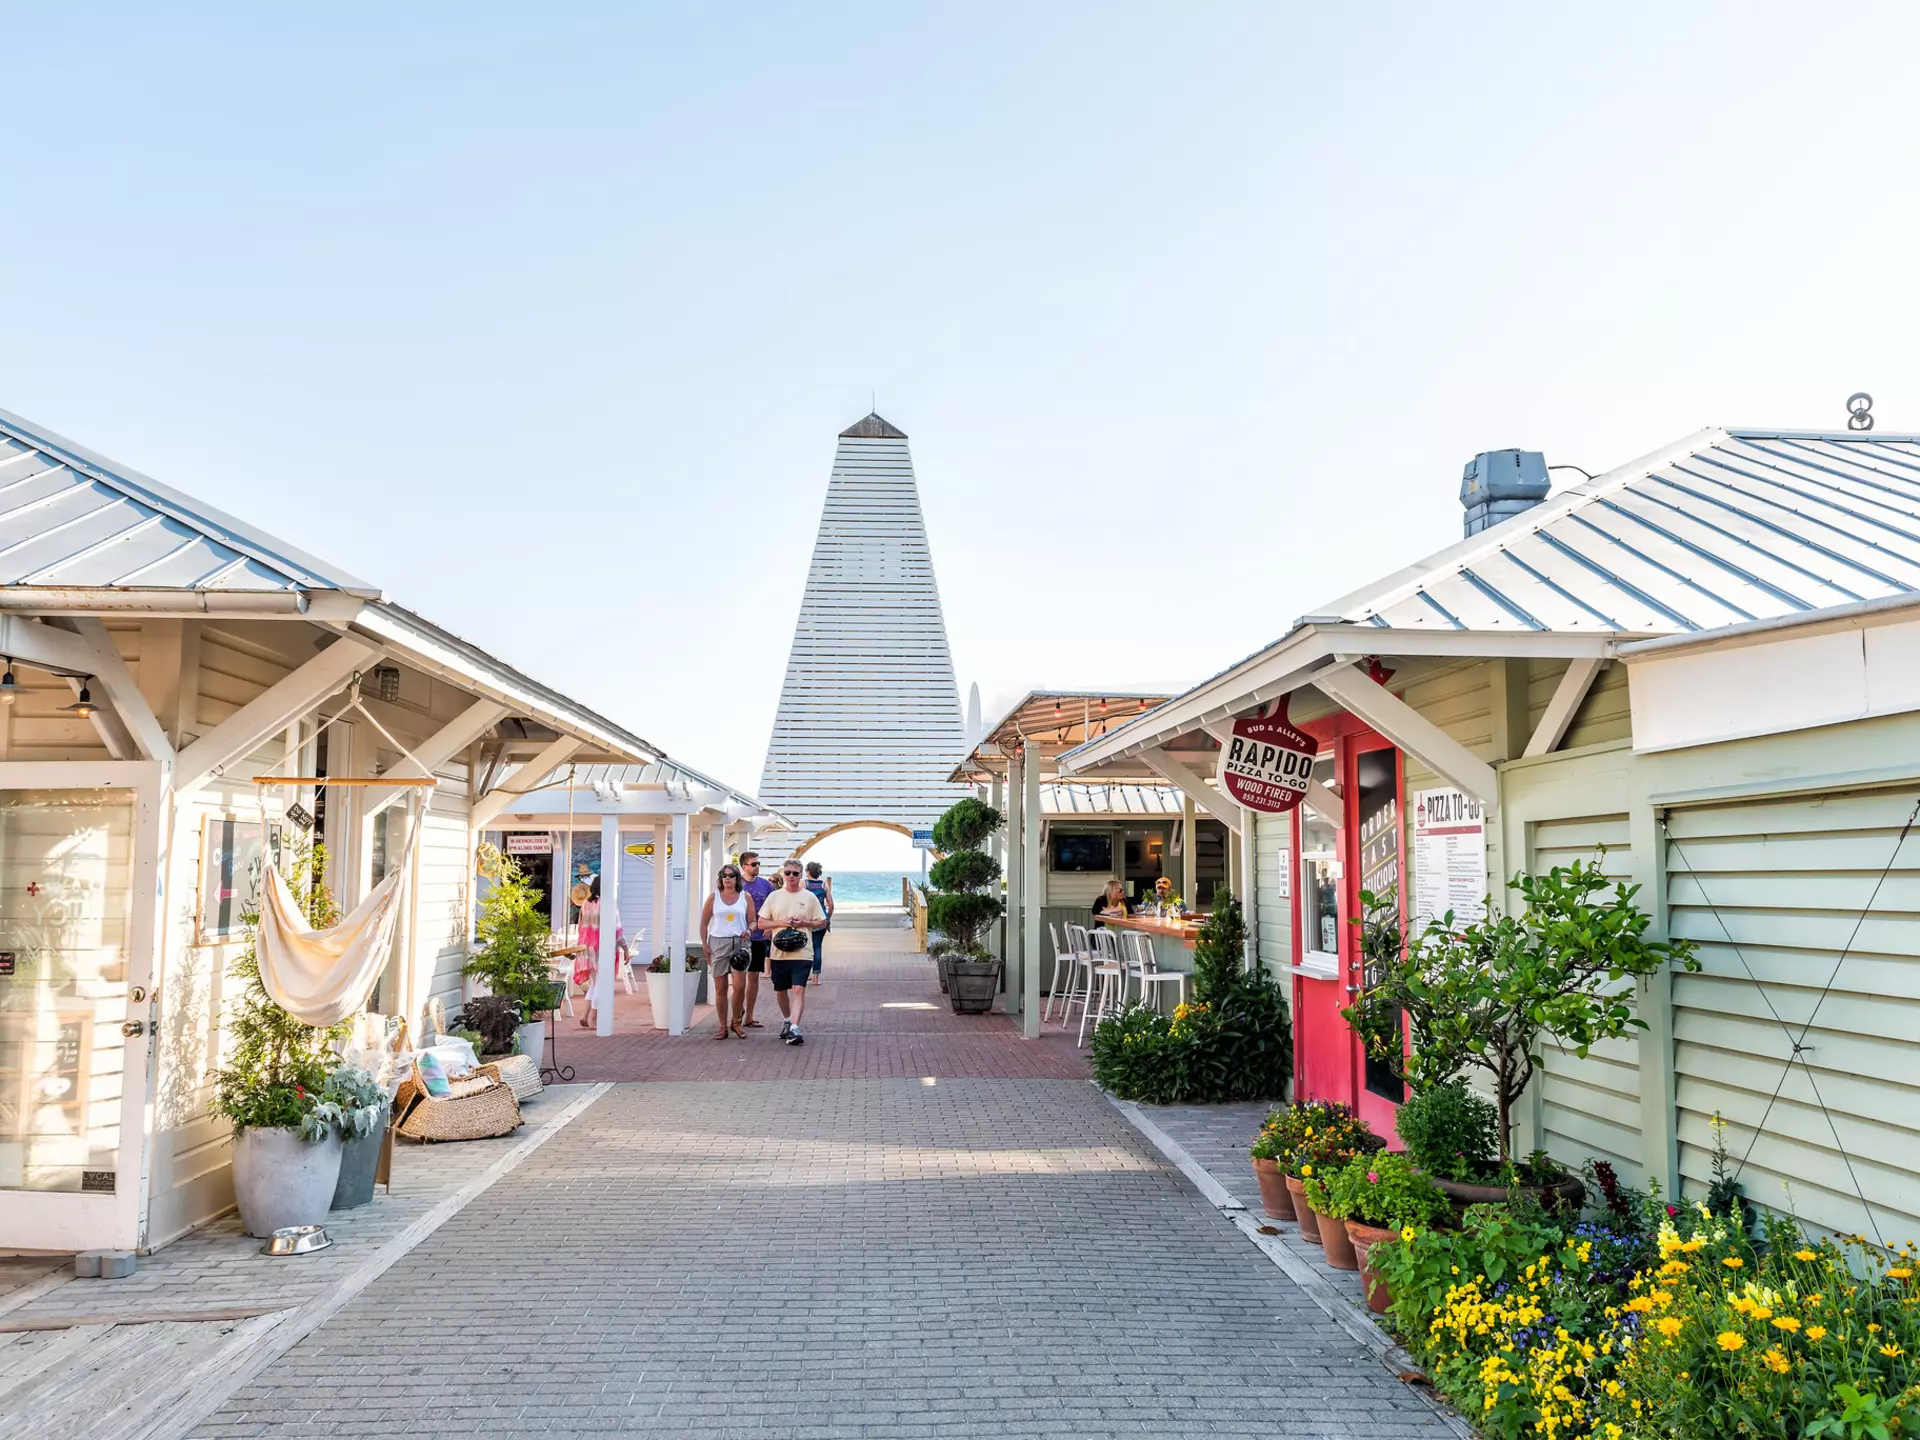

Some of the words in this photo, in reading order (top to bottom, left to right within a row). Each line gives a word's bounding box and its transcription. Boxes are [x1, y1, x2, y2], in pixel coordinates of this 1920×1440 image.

[1247, 725, 1265, 734] BUD
[1276, 726, 1307, 747] ALLEY'S
[1229, 737, 1313, 779] RAPIDO
[1227, 762, 1262, 778] PIZZA
[1268, 772, 1307, 789] TO-GO
[1237, 778, 1263, 794] WOOD
[1264, 786, 1292, 802] FIRED
[1242, 793, 1280, 809] 850.231.3113
[1361, 798, 1396, 842] ORDER
[1427, 795, 1451, 822] PIZZA
[1452, 793, 1480, 820] TO-GO
[1362, 828, 1397, 872] FAST
